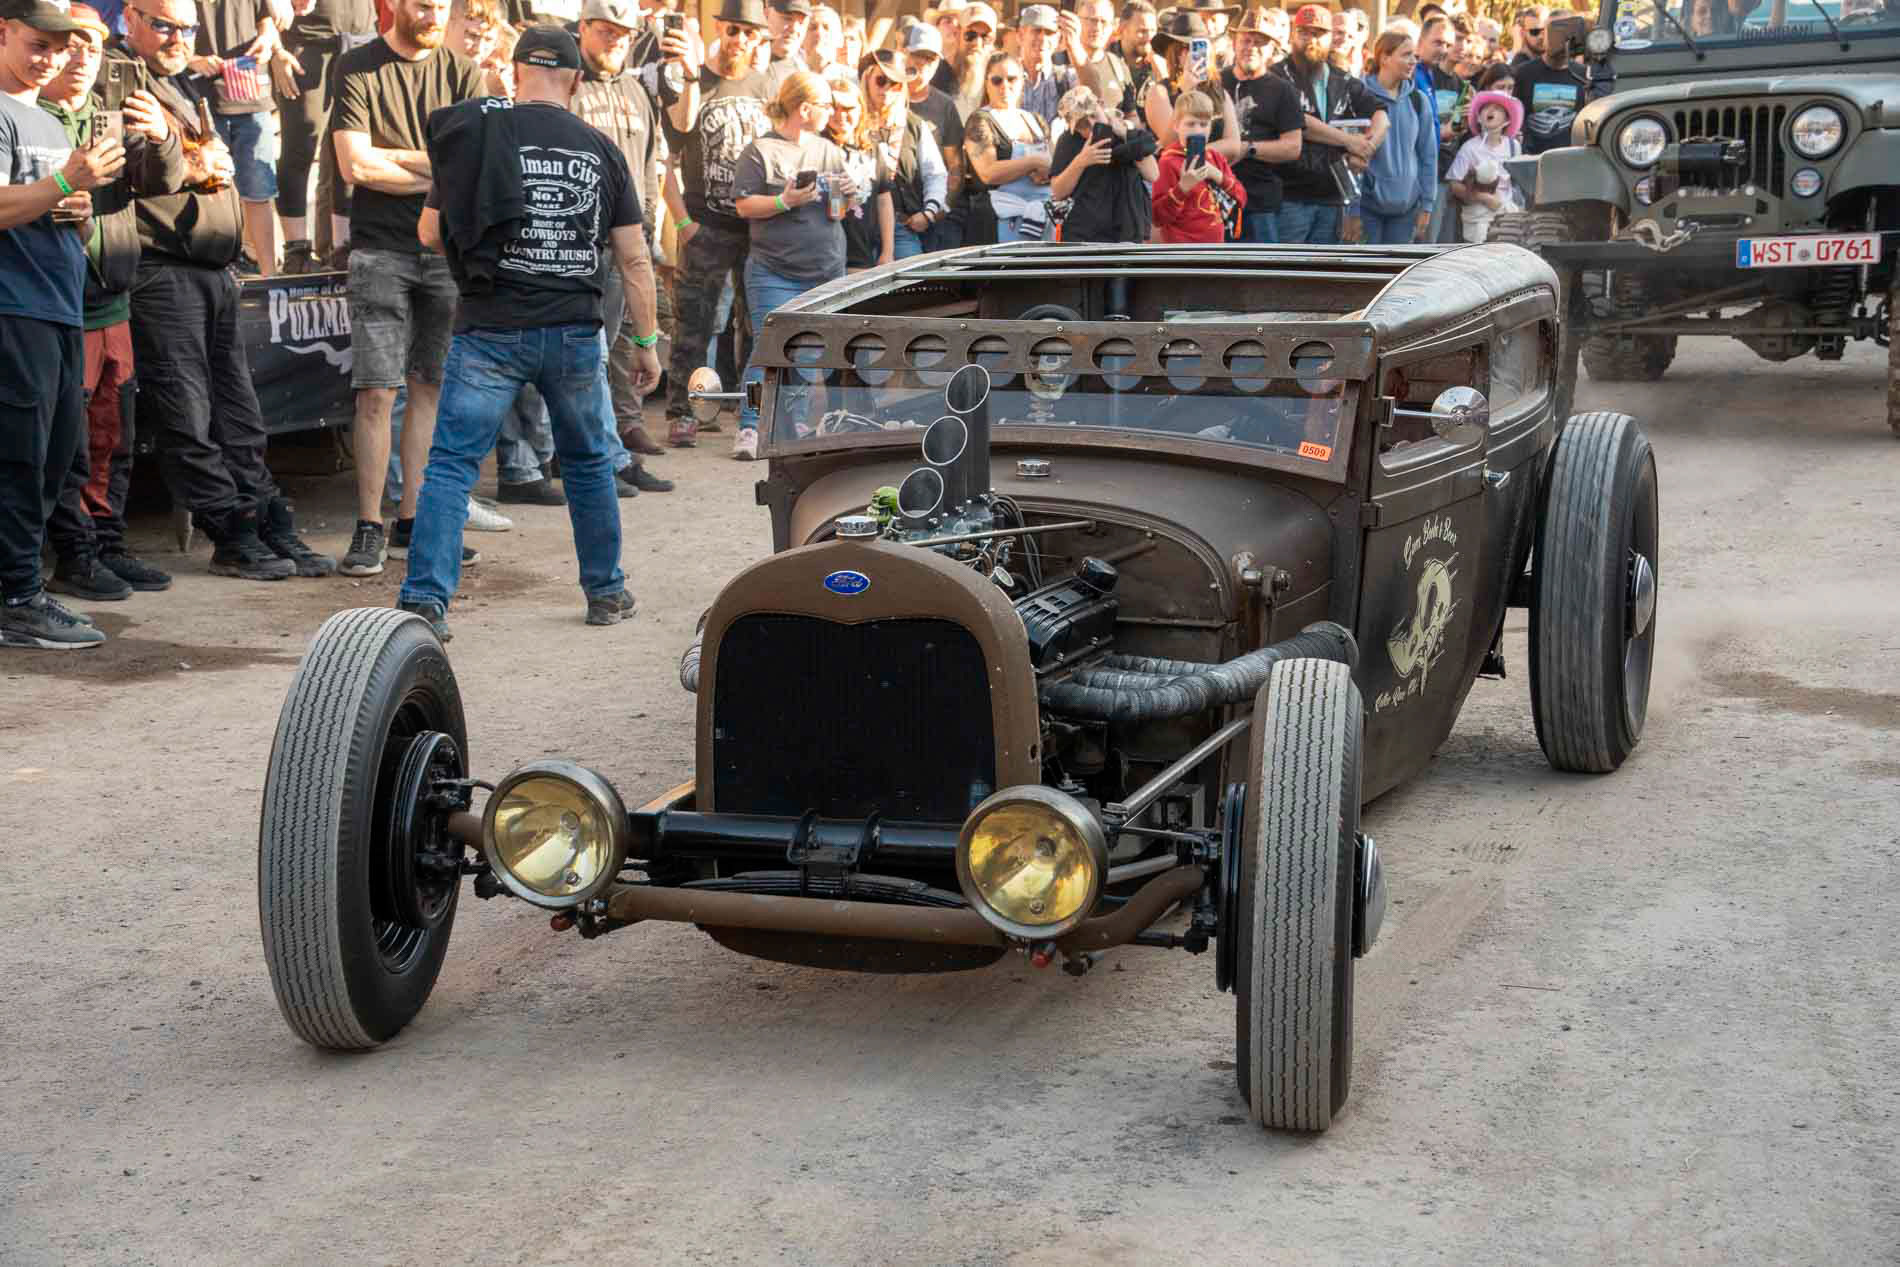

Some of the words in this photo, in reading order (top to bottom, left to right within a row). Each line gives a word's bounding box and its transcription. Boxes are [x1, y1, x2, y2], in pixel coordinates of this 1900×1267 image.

[519, 154, 564, 175] lman
[567, 159, 601, 188] City
[531, 190, 564, 202] No.1
[521, 227, 577, 241] COWBOYS
[541, 240, 558, 249] AND
[558, 249, 593, 261] MUSIC
[1752, 241, 1797, 264] WST
[1816, 239, 1875, 262] 0761
[268, 288, 352, 343] PULLMA
[1302, 445, 1326, 457] 0509
